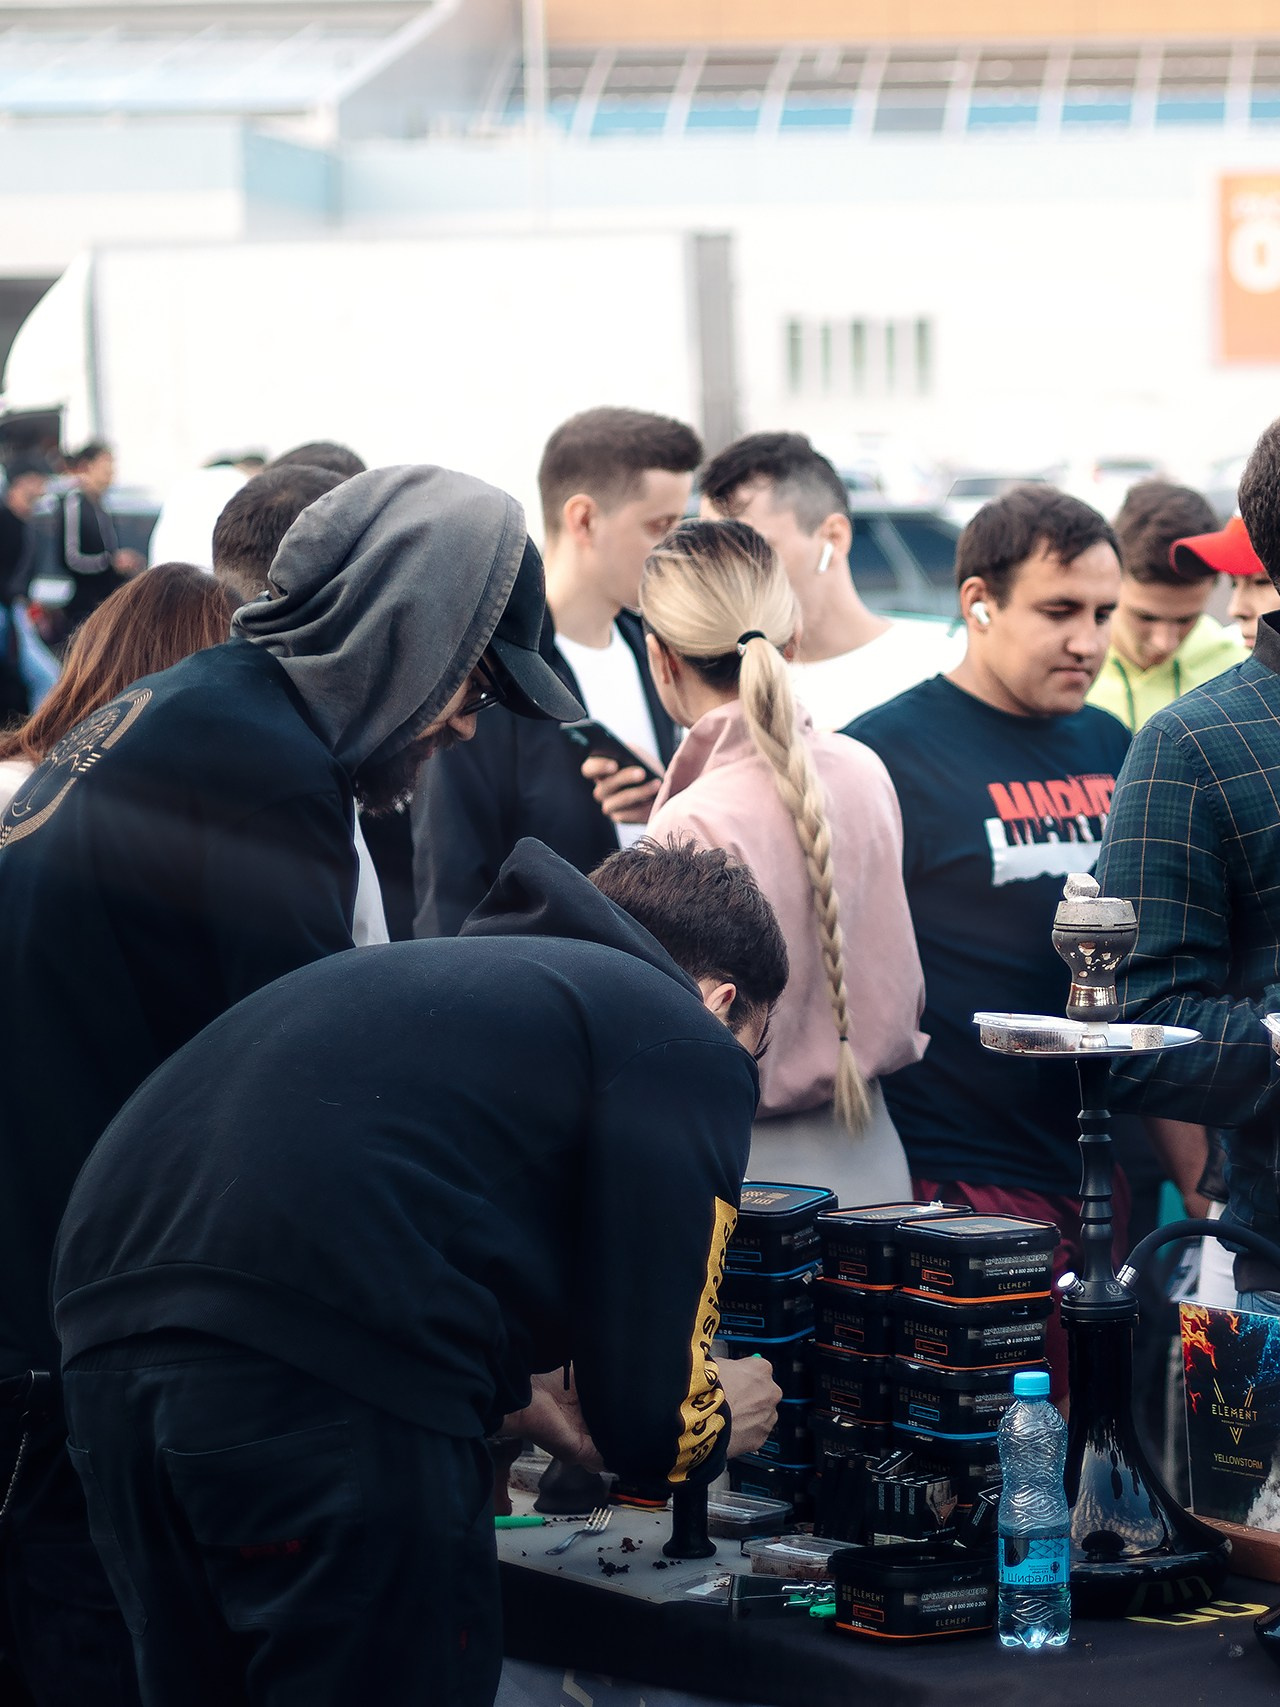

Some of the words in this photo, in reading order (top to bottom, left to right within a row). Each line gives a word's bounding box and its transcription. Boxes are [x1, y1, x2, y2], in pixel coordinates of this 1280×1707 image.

[998, 1280, 1032, 1290] ELEMENT
[995, 1349, 1027, 1360] ELEMENT
[1211, 1403, 1258, 1422] ELEMENT
[1213, 1453, 1264, 1470] YELLOWSTORM
[1007, 1572, 1057, 1585] Шифалы
[853, 1587, 885, 1604] ELEMENT
[935, 1616, 971, 1627] ELEMENT
